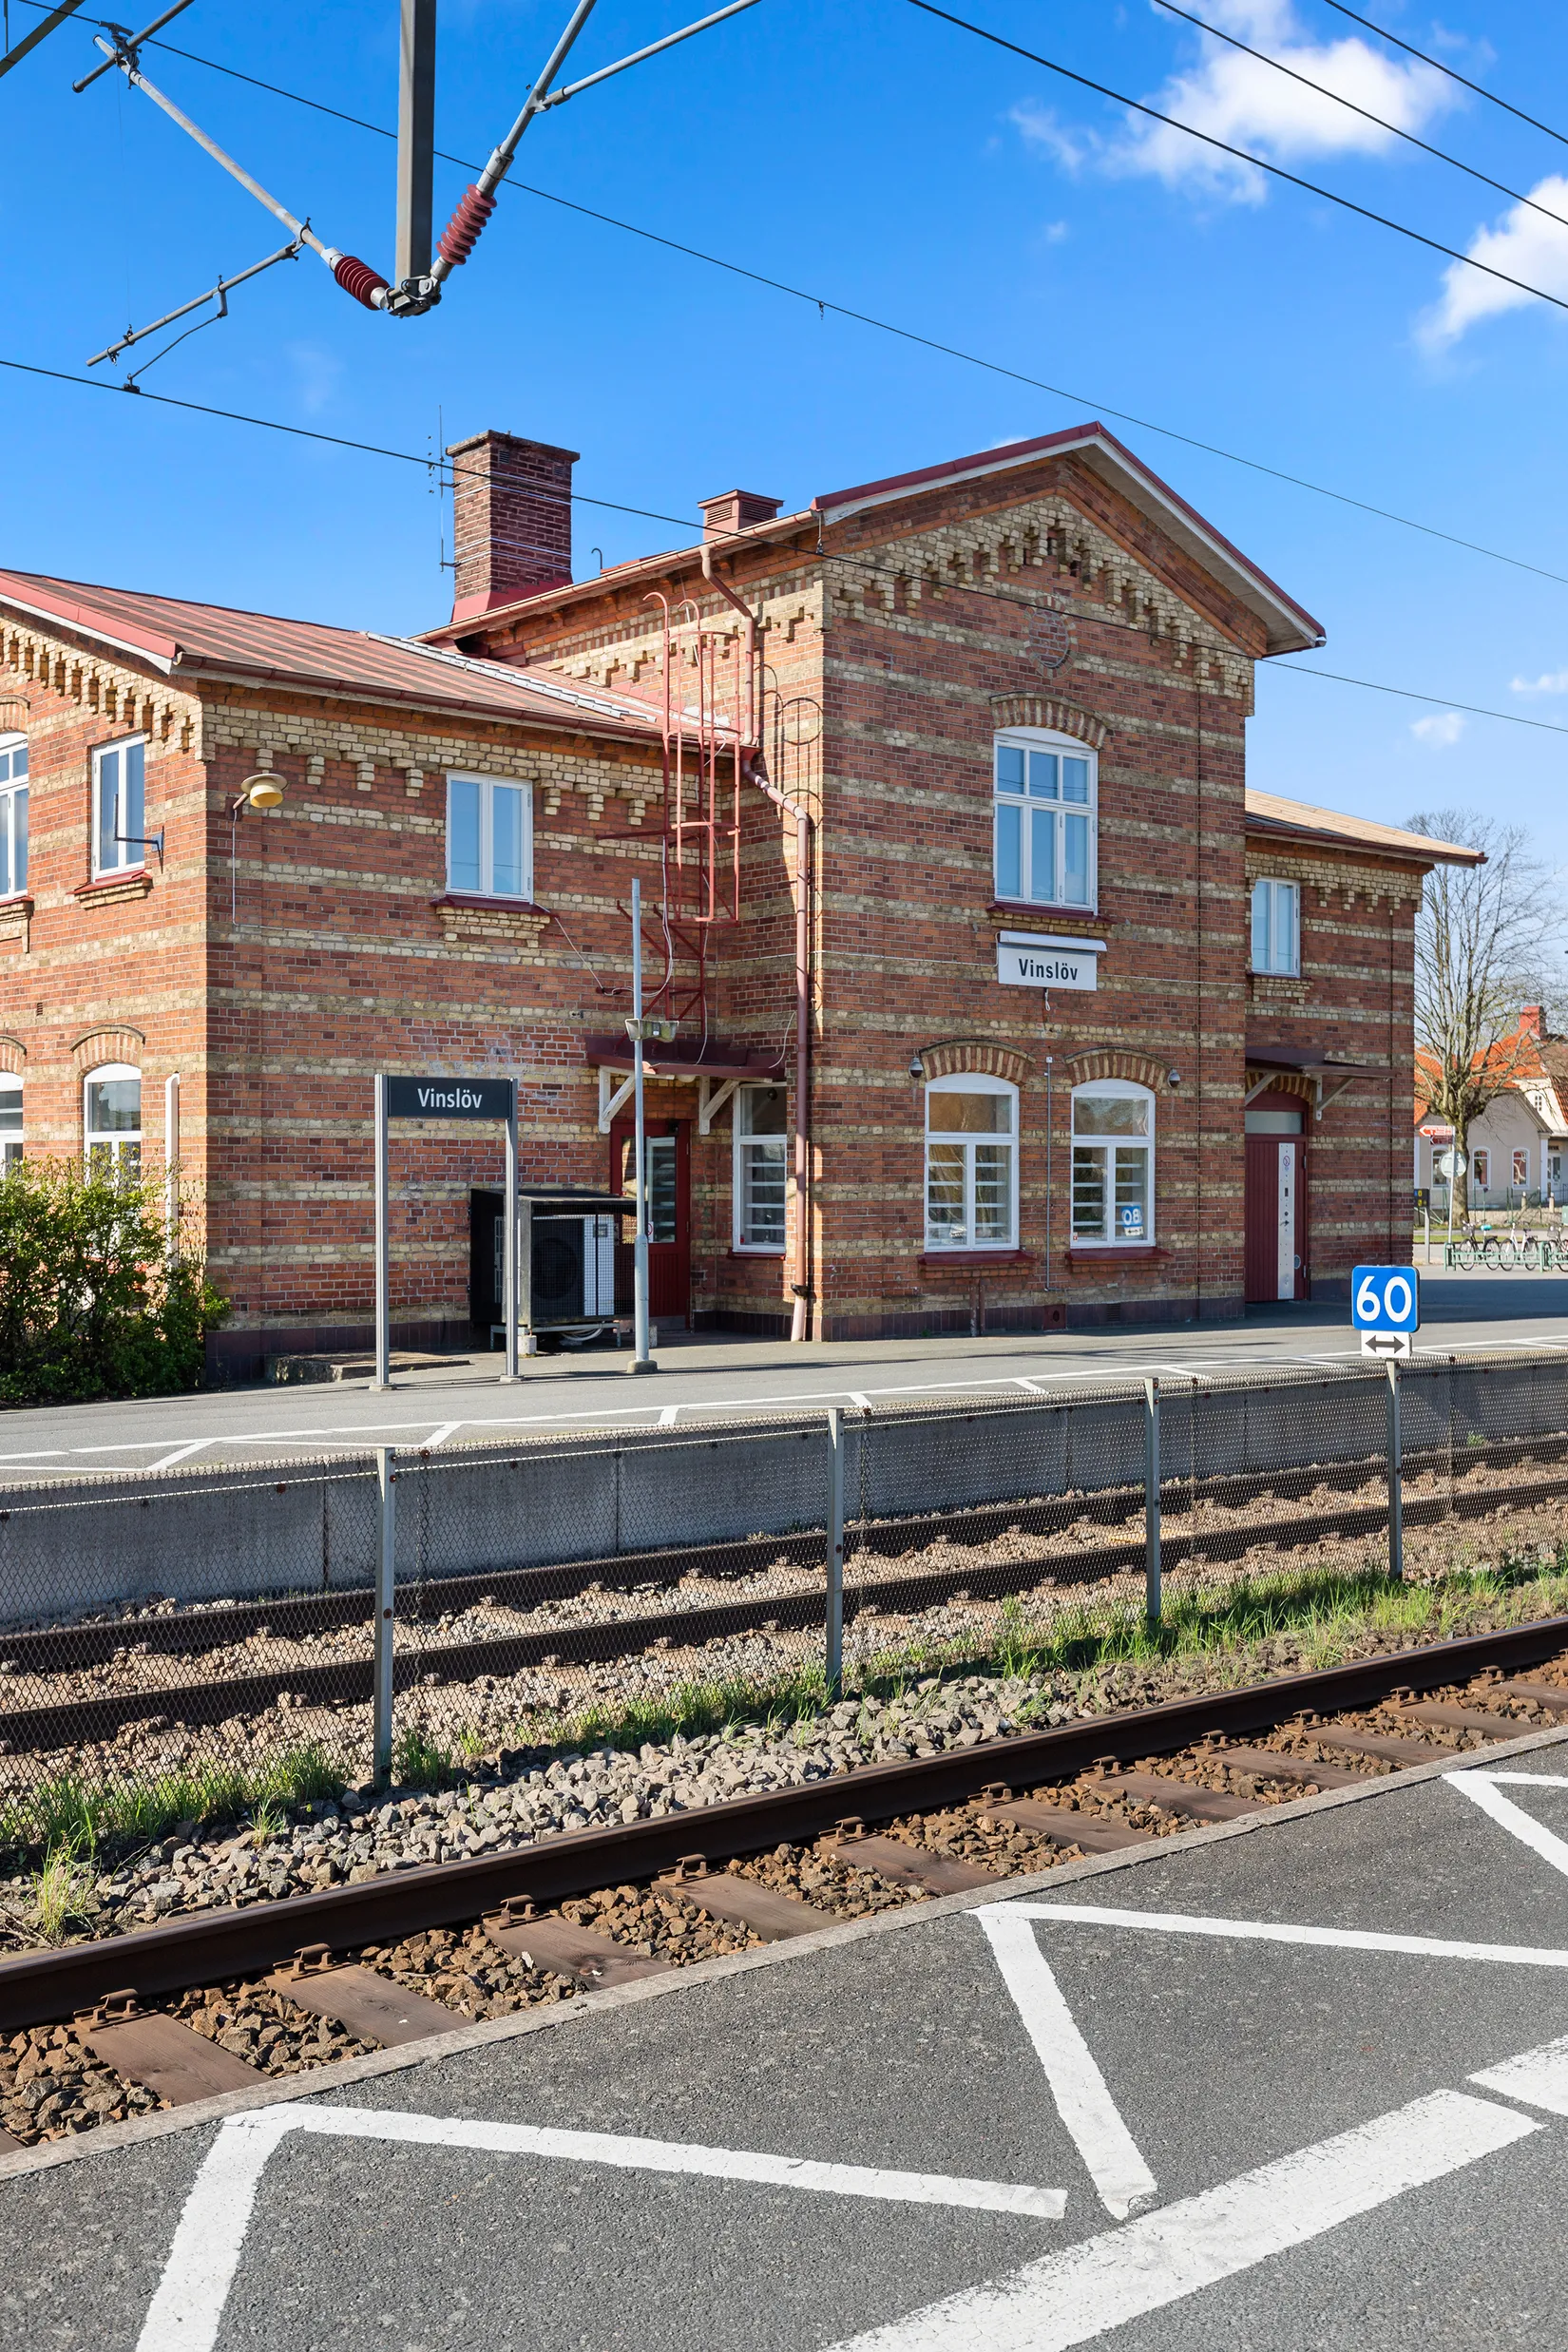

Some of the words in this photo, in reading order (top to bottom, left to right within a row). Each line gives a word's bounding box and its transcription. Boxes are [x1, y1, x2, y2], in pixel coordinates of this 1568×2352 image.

[1018, 958, 1078, 981] Vinslöv
[417, 1087, 483, 1109] Vinslöv
[1356, 1275, 1412, 1323] 60
